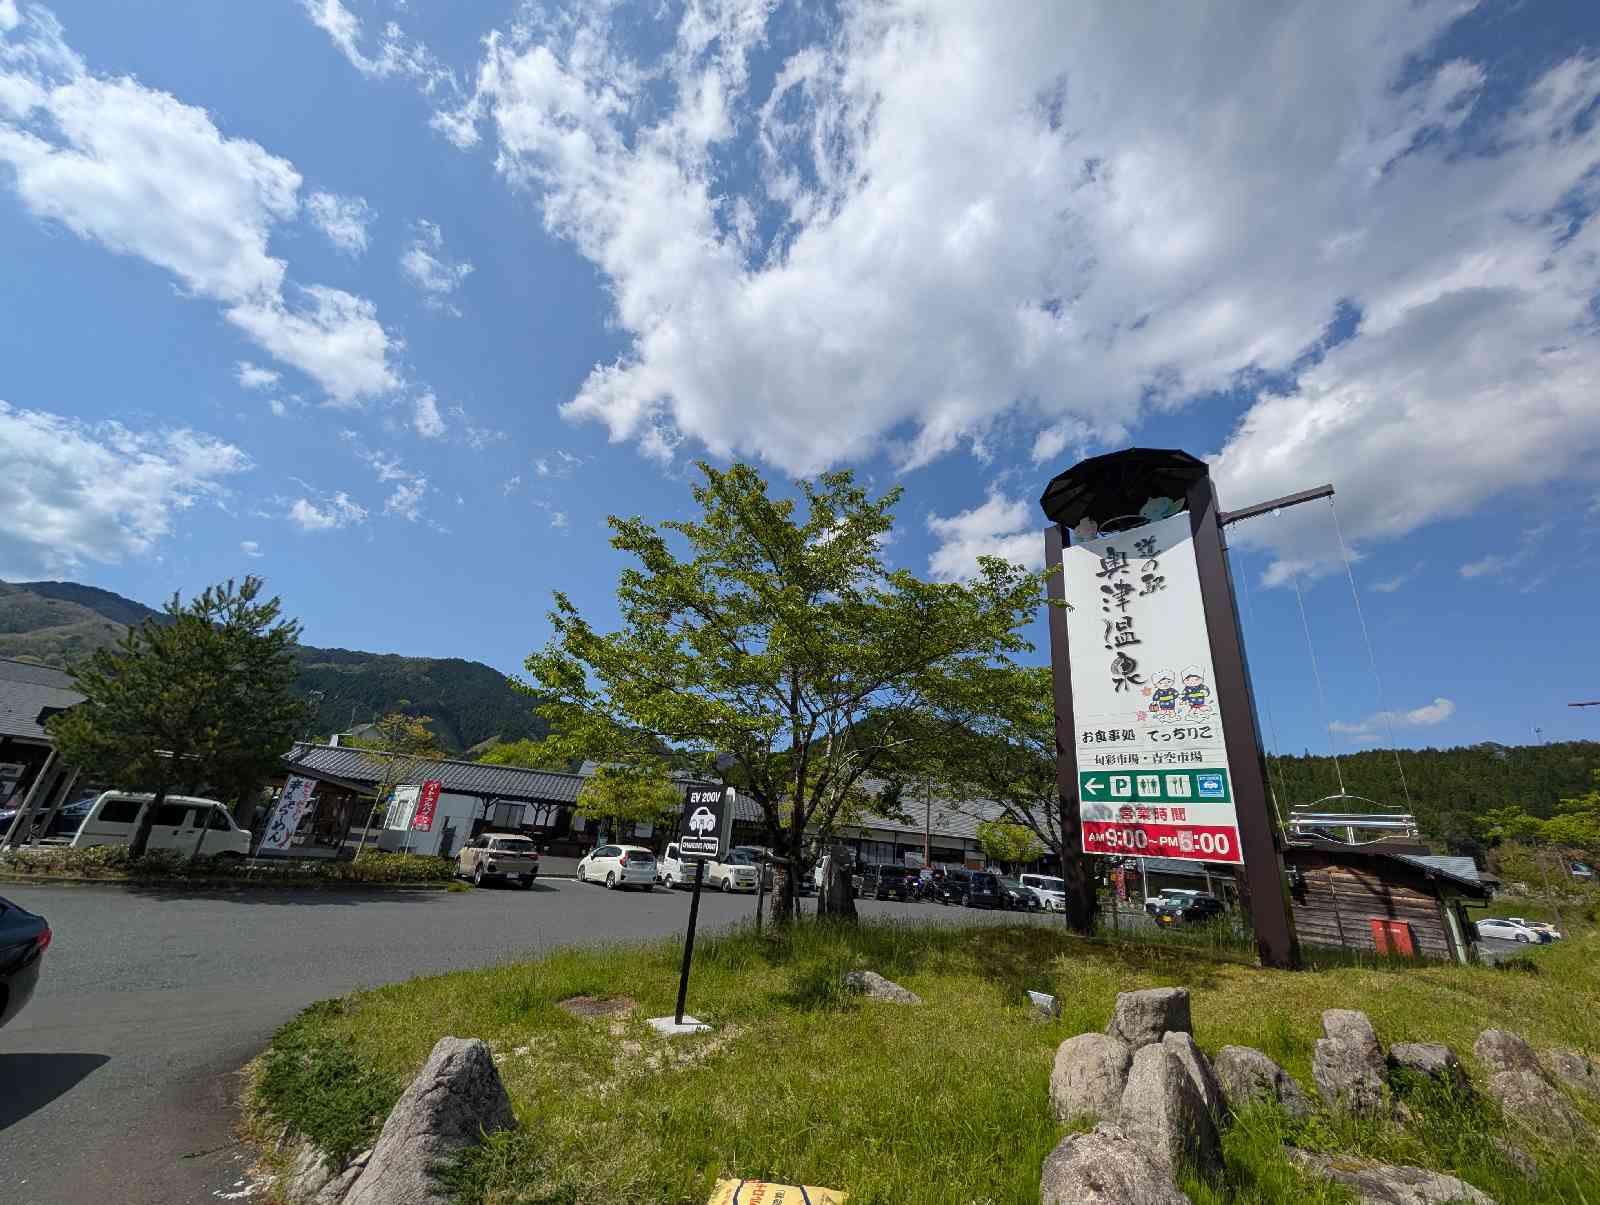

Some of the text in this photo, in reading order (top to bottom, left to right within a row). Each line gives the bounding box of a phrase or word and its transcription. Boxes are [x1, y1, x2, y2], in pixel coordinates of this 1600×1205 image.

[1134, 535, 1167, 596] 道の駅
[1096, 546, 1148, 693] 奥津温泉
[1082, 726, 1213, 743] お食事処 てっちりこ
[691, 792, 721, 803] EV 200V
[1119, 805, 1186, 821] 営業時間
